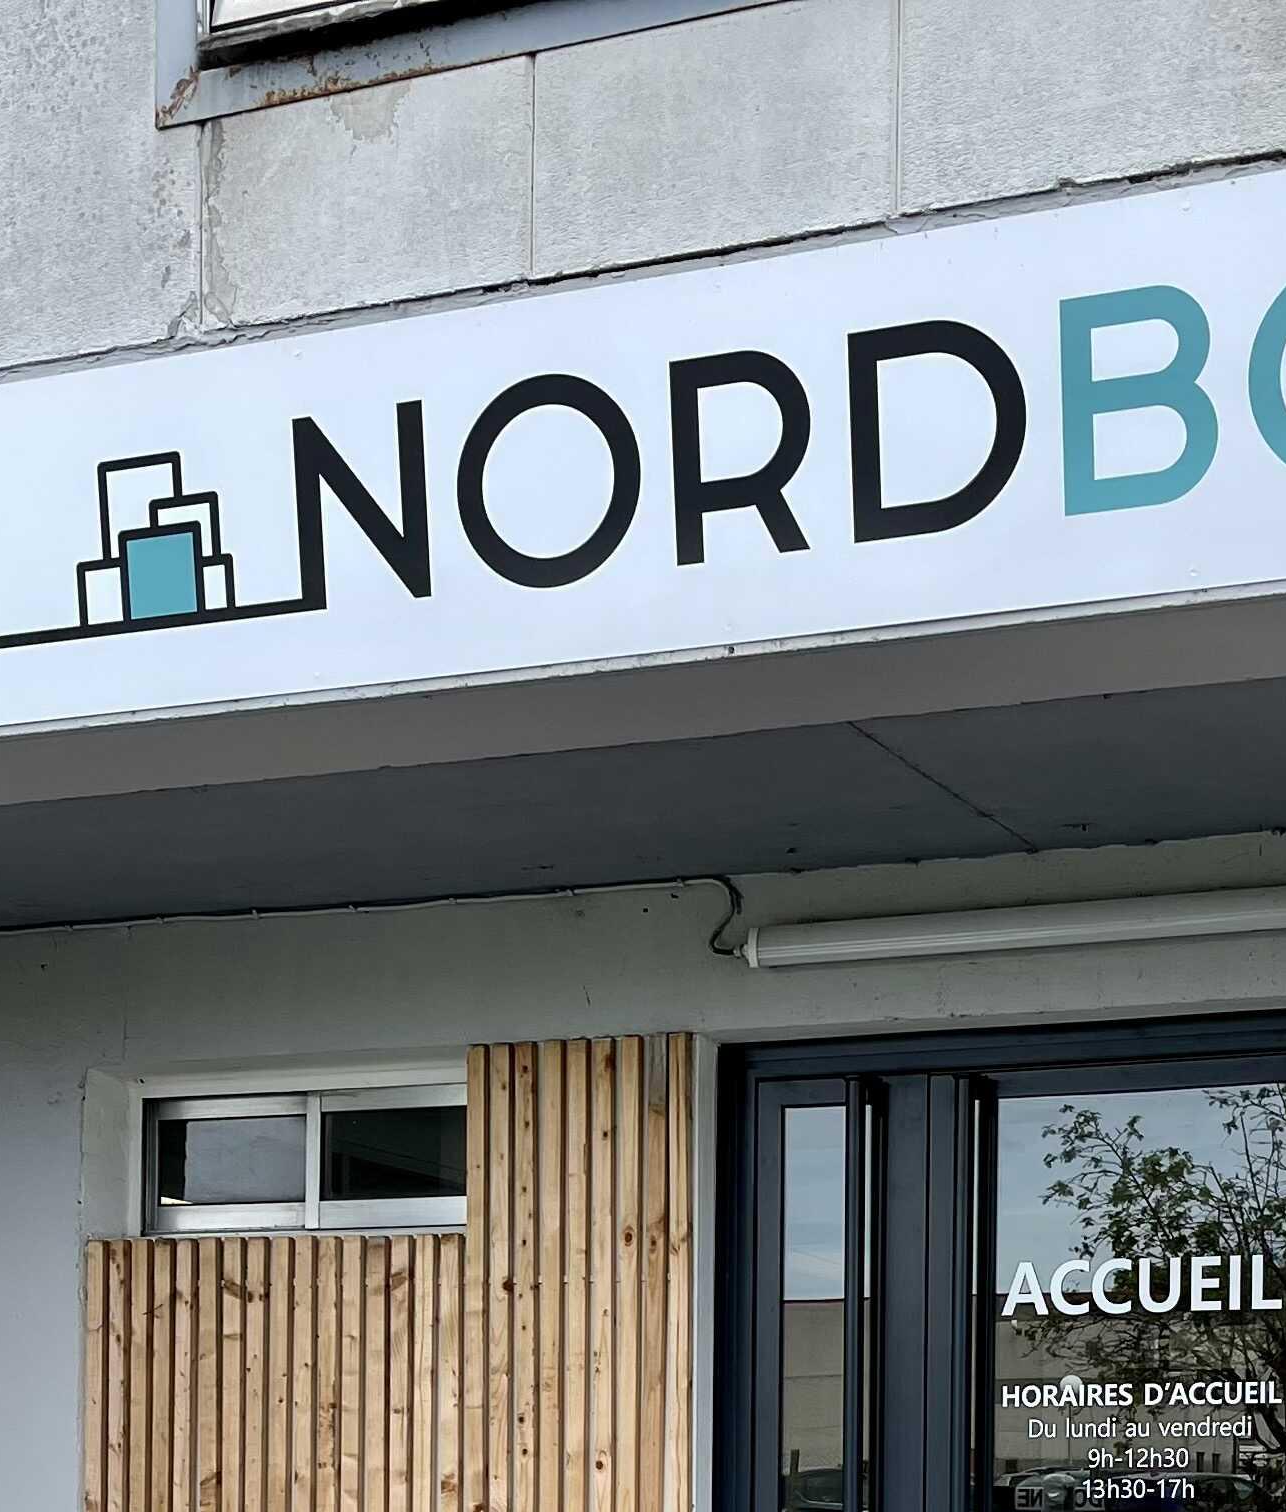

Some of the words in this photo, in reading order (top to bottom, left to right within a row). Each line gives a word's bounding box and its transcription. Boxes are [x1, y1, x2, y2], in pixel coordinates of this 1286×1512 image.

[1000, 1253, 1284, 1317] ACCUEIL
[1001, 1382, 1134, 1408] HORAIRES
[1143, 1380, 1283, 1406] D'ACCUEIL
[1028, 1419, 1057, 1438] Du
[1065, 1416, 1117, 1438] lundi
[1125, 1421, 1151, 1438] au
[1158, 1415, 1253, 1438] vendredi
[1087, 1447, 1189, 1469] 9h-12h30
[1081, 1478, 1195, 1500] 13h30-17h
